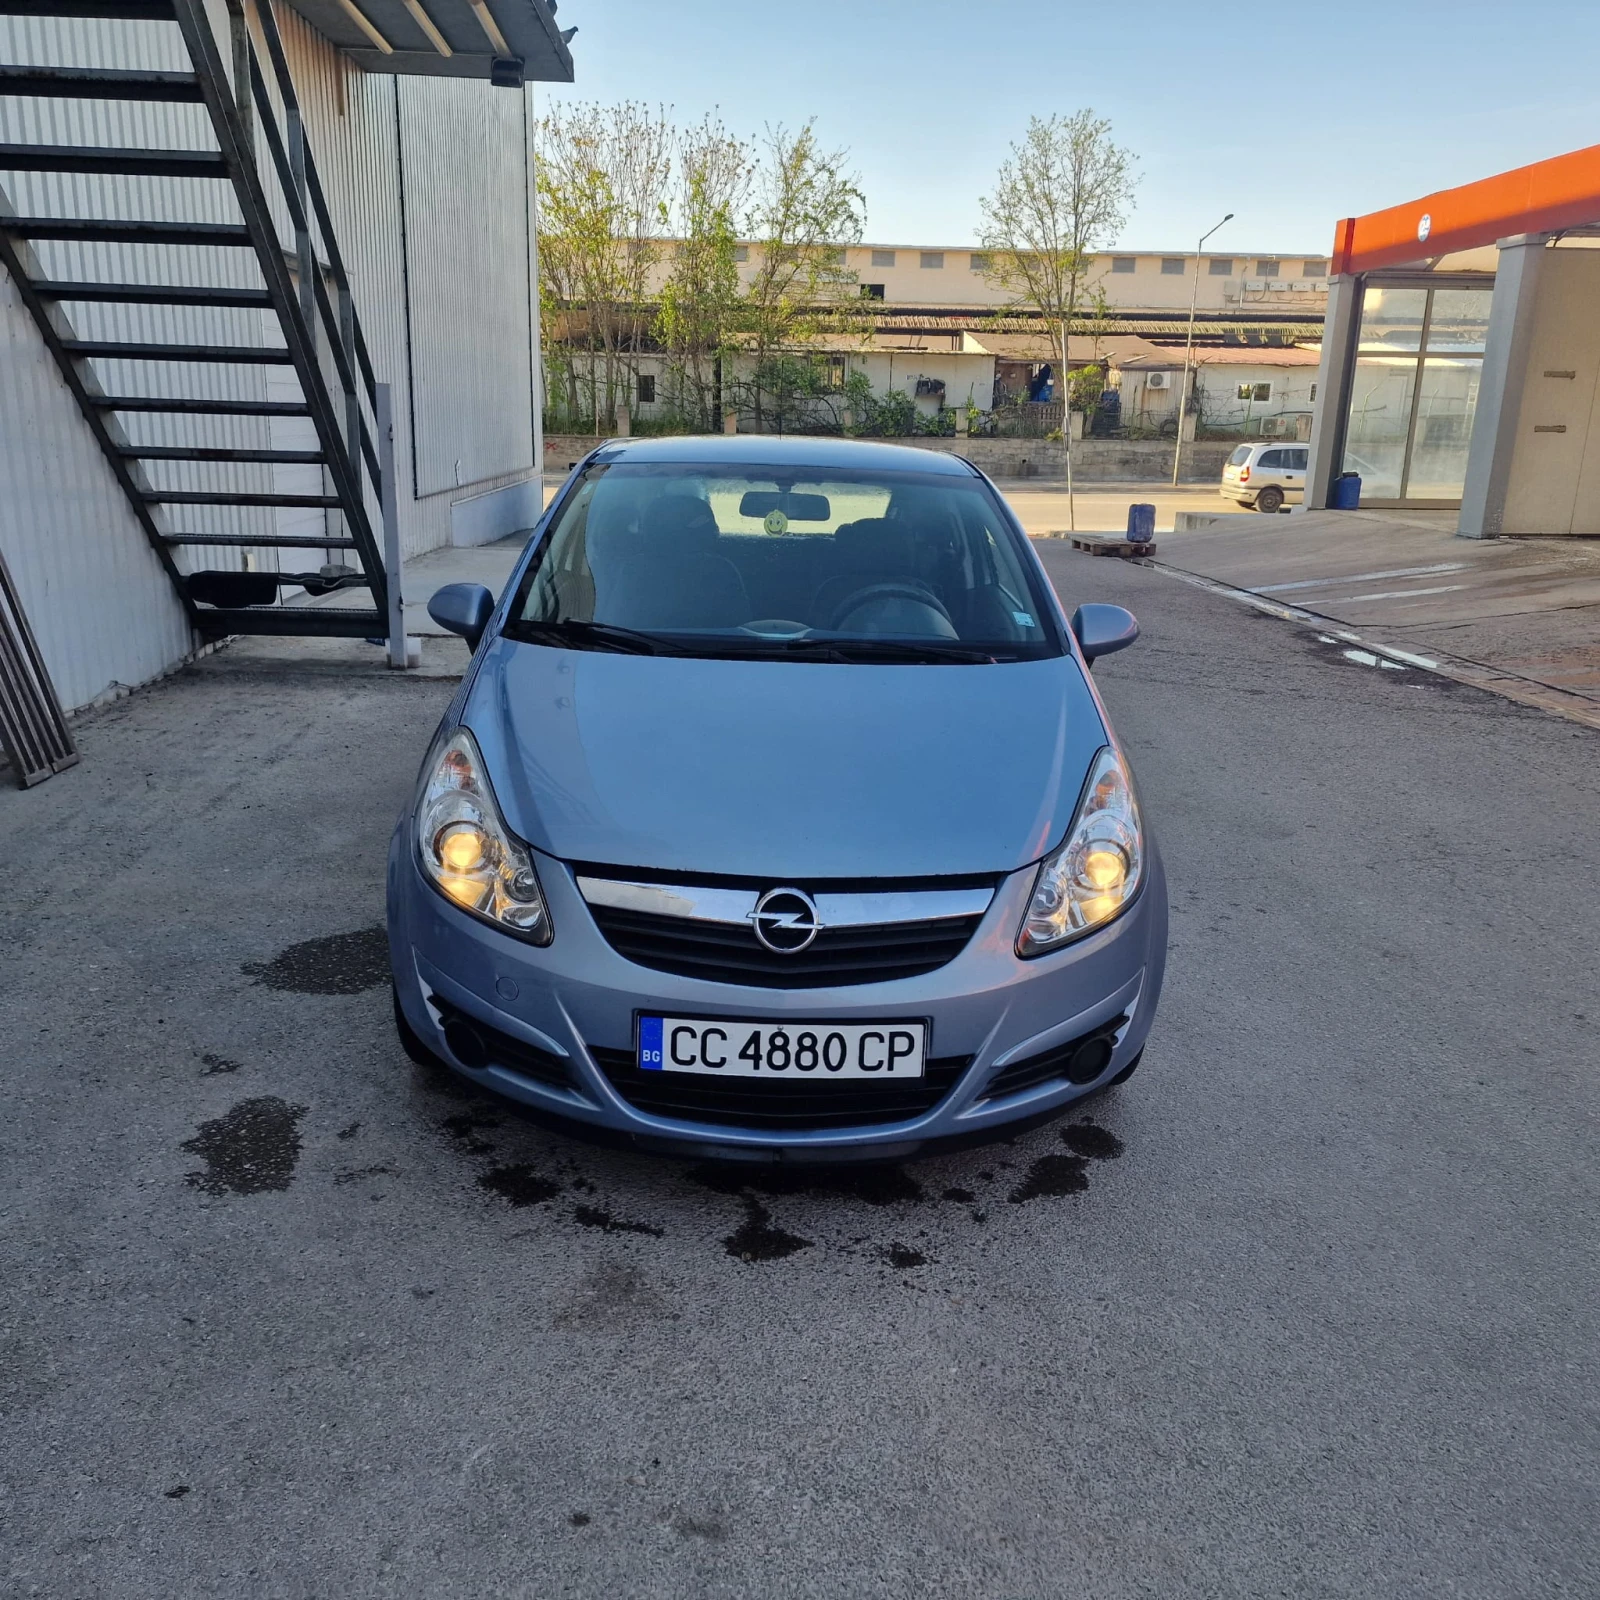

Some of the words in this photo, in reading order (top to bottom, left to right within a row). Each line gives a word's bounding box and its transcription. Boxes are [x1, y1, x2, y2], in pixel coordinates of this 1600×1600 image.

[642, 1049, 661, 1063] BG
[670, 1025, 728, 1069] CC
[737, 1030, 848, 1072] 4880
[858, 1031, 915, 1072] CP
